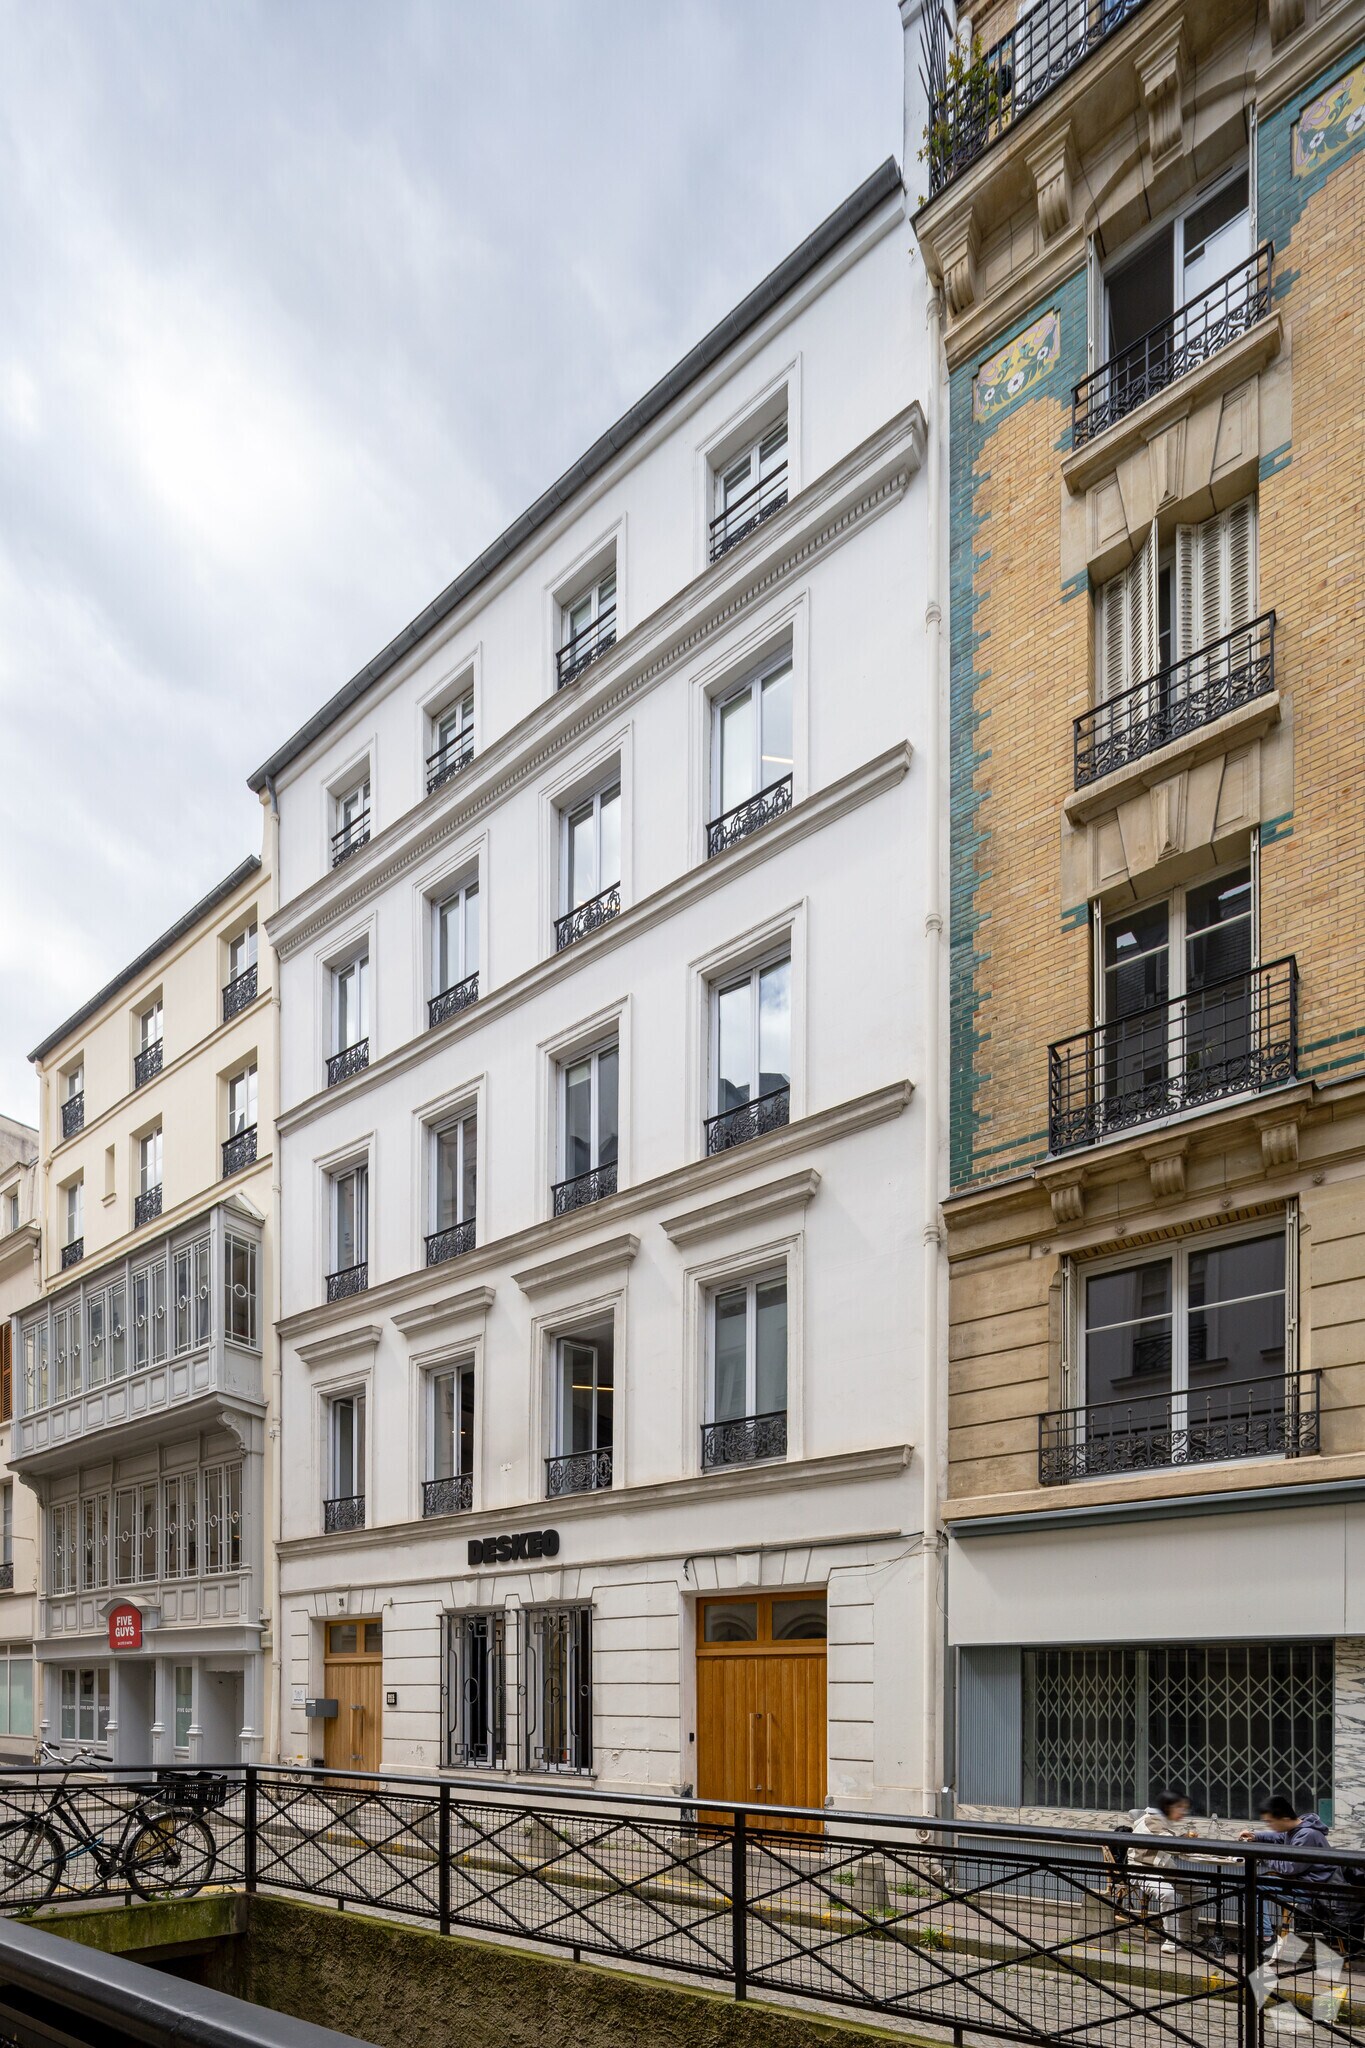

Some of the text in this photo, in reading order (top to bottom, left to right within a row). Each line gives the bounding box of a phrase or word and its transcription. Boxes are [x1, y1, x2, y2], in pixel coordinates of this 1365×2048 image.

[468, 1529, 560, 1565] DESKEO
[116, 1615, 133, 1626] FIVE
[115, 1626, 135, 1637] GUYS
